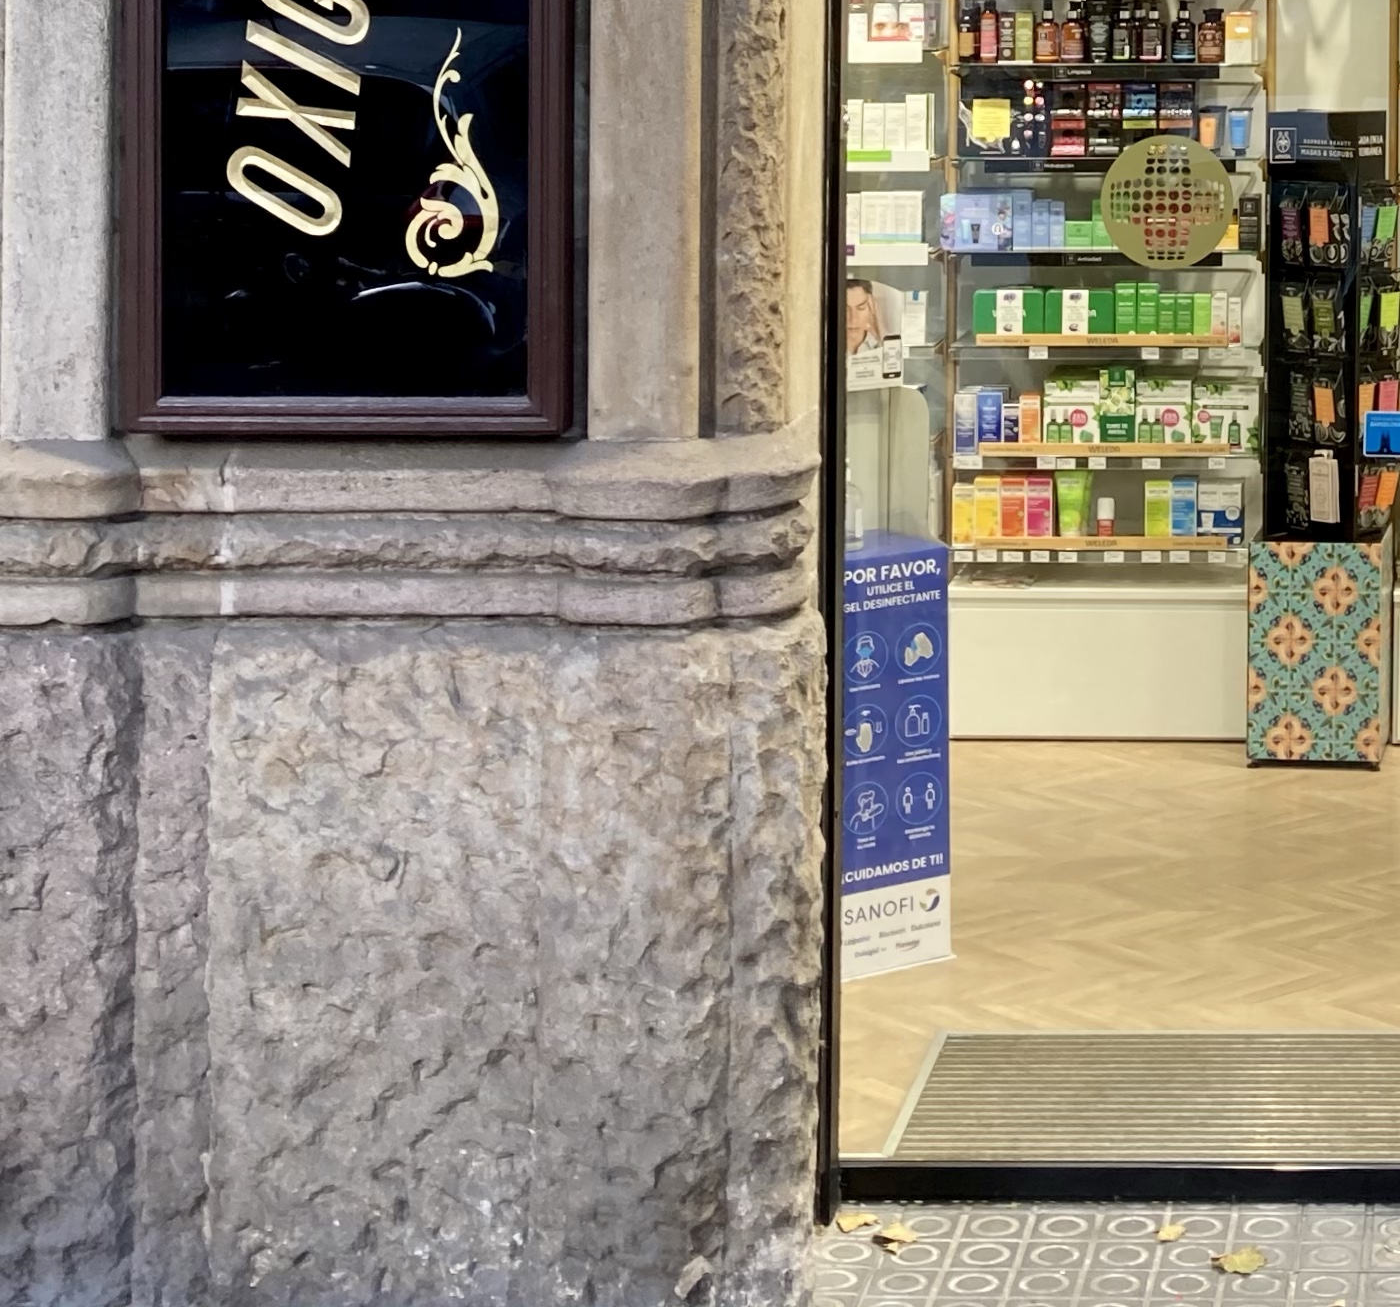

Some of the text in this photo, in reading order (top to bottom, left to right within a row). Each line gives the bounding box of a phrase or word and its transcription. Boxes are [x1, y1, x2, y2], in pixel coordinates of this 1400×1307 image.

[843, 558, 942, 587] POR FAVOR,
[866, 580, 915, 597] UTILICE EL
[843, 589, 942, 614] GEL DESINFECTANTE
[911, 855, 927, 868] DE
[928, 852, 944, 866] TI!
[844, 895, 914, 926] SANOFI
